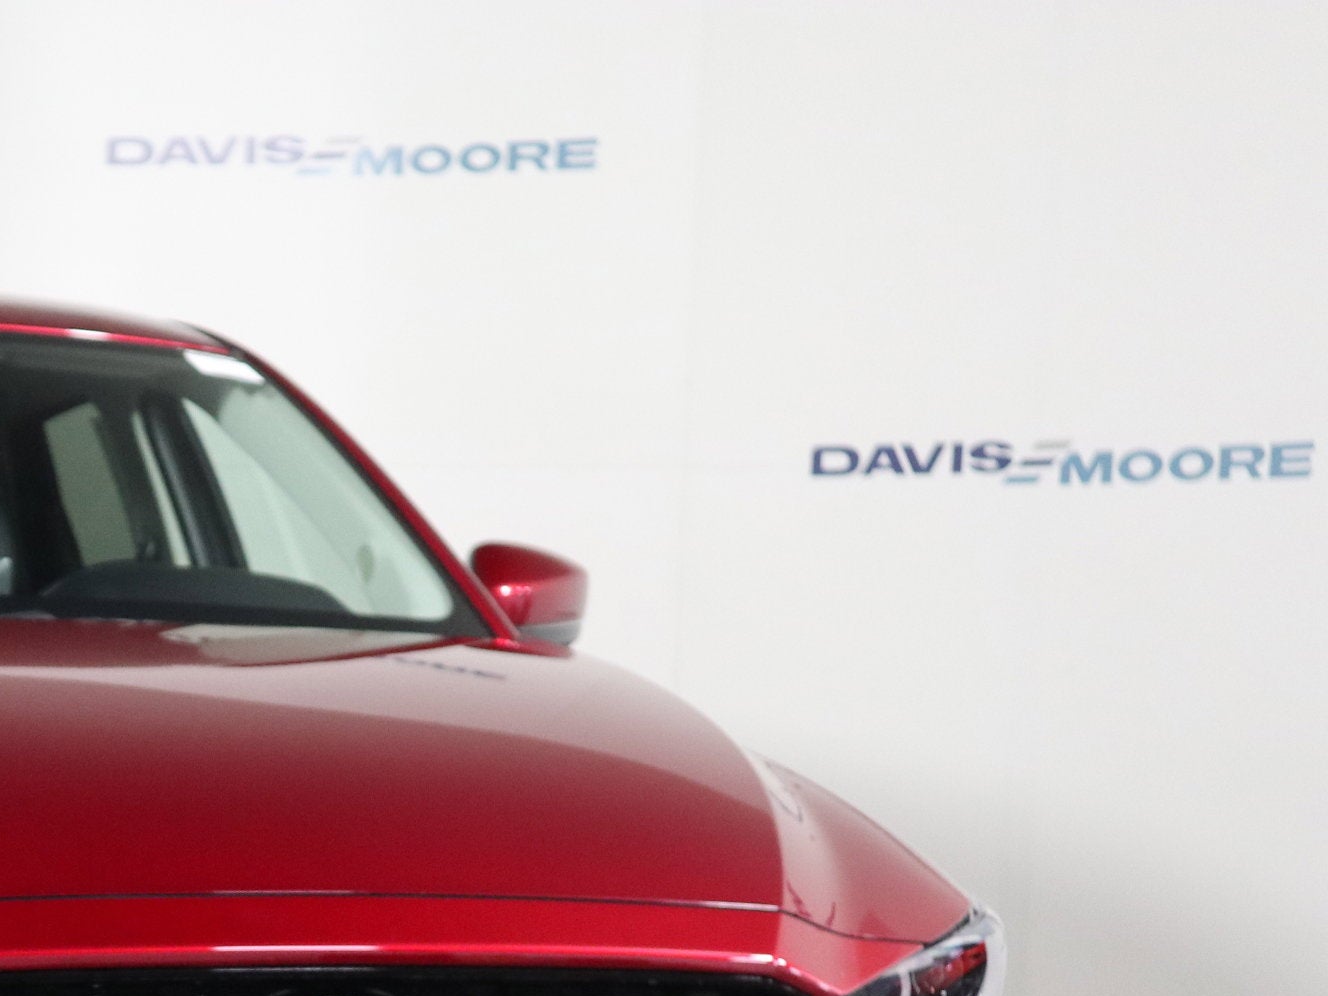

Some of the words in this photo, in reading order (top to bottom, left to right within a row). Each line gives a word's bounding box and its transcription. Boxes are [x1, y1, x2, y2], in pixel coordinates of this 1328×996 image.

[105, 134, 306, 166] DAVIS
[353, 136, 600, 176] MOORE
[809, 440, 1013, 476] DAVIS
[1059, 441, 1316, 485] MOORE
